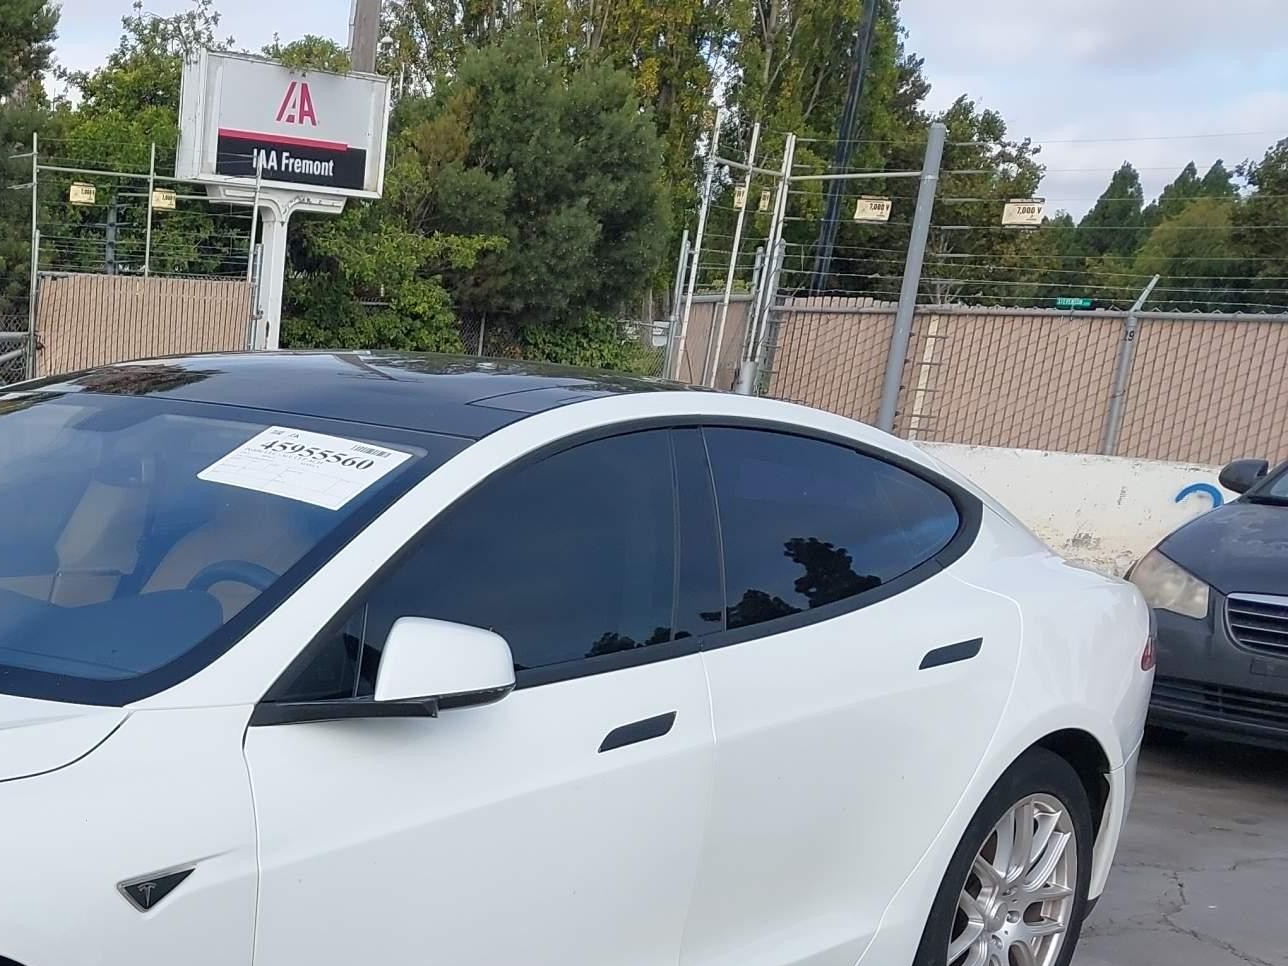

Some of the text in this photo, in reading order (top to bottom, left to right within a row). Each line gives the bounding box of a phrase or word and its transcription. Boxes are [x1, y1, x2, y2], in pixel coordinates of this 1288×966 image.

[252, 148, 334, 176] IAA Fremont
[1016, 206, 1042, 215] 7,000 V
[260, 440, 374, 470] 45955560
